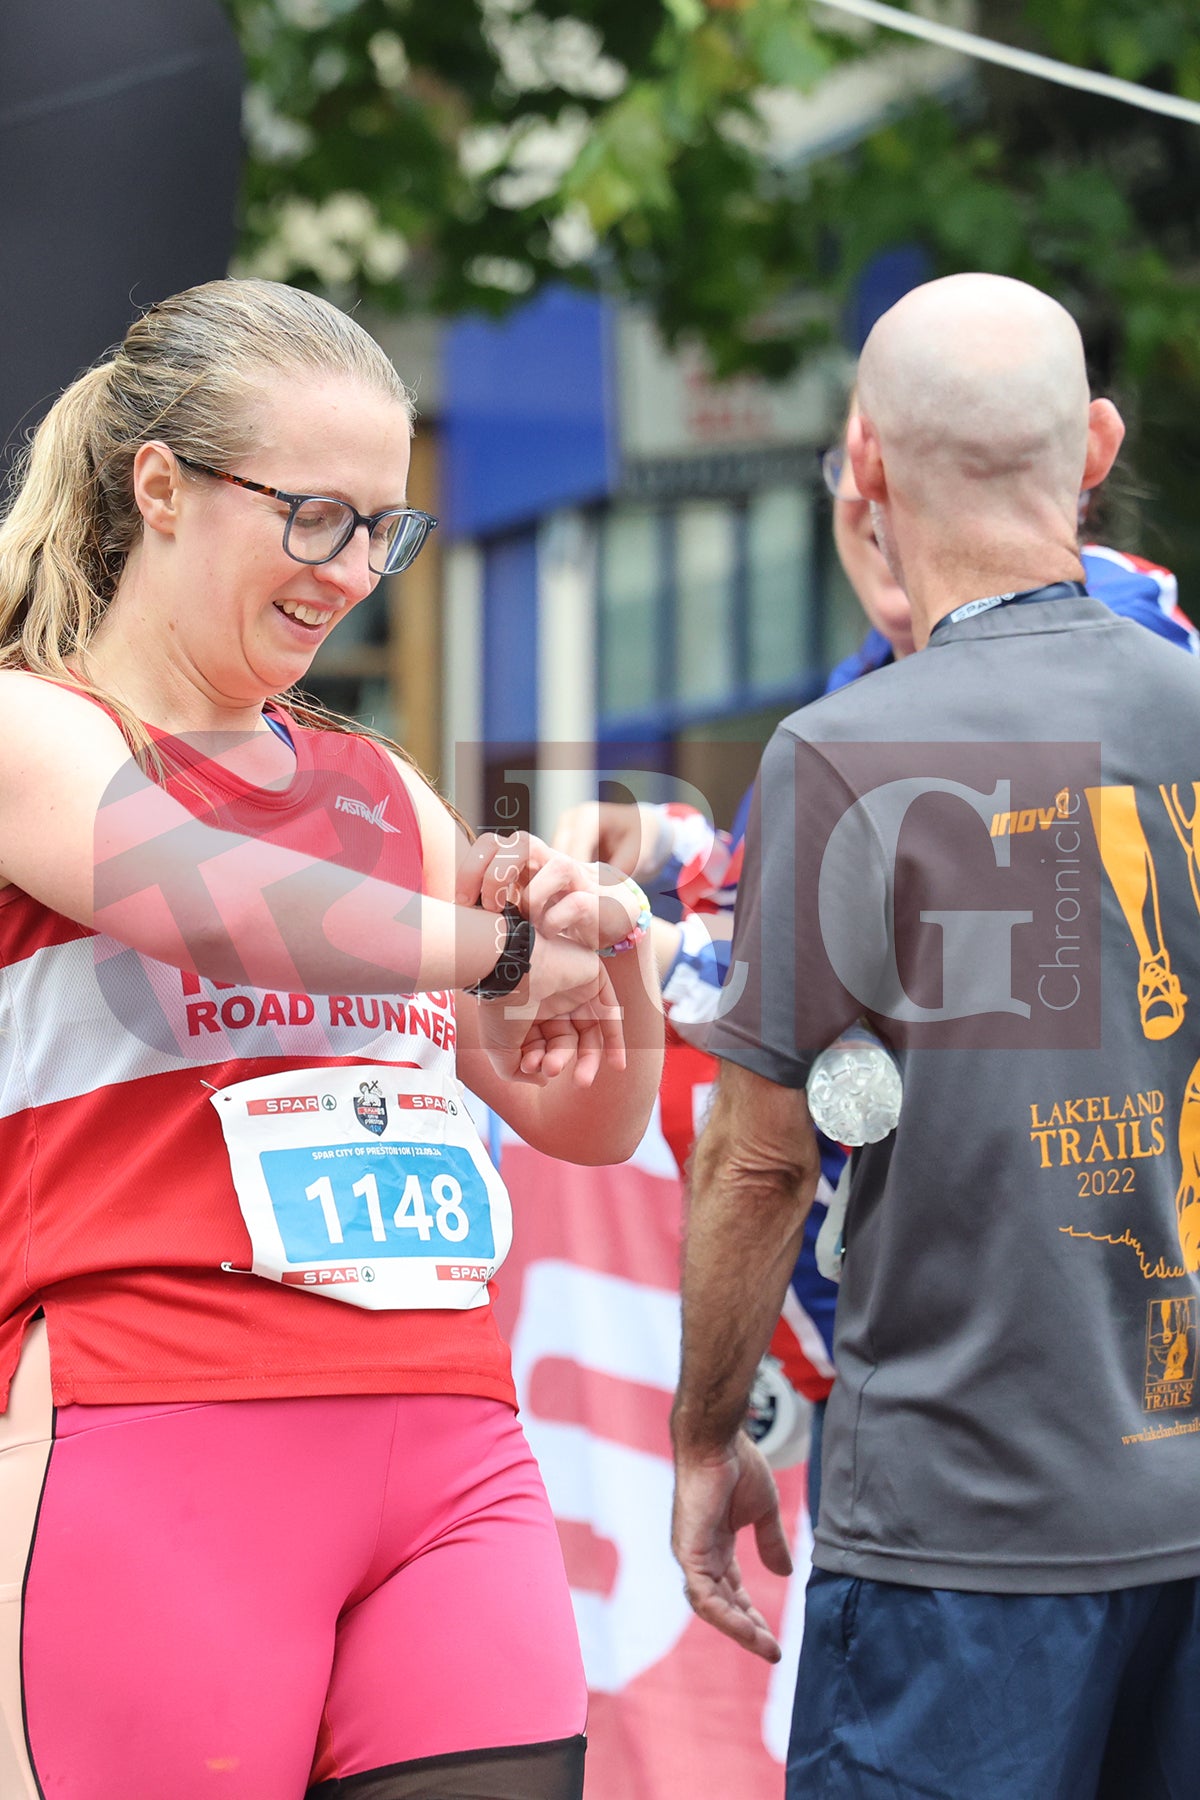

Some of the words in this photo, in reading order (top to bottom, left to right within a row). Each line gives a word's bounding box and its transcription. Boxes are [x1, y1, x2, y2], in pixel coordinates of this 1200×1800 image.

[185, 993, 315, 1036] ROAD
[265, 1097, 318, 1112] SPAR
[1029, 1089, 1165, 1128] LAKELAND
[311, 1150, 335, 1160] SPAR
[335, 1147, 354, 1158] CITY
[354, 1146, 365, 1156] OF
[365, 1146, 398, 1156] PRESTON
[1030, 1116, 1166, 1168] TRAILS
[1077, 1167, 1135, 1197] 2022
[305, 1173, 470, 1244] 1148
[303, 1268, 358, 1283] SPAR
[450, 1266, 486, 1280] SPAR
[1145, 1391, 1192, 1410] TRAILS
